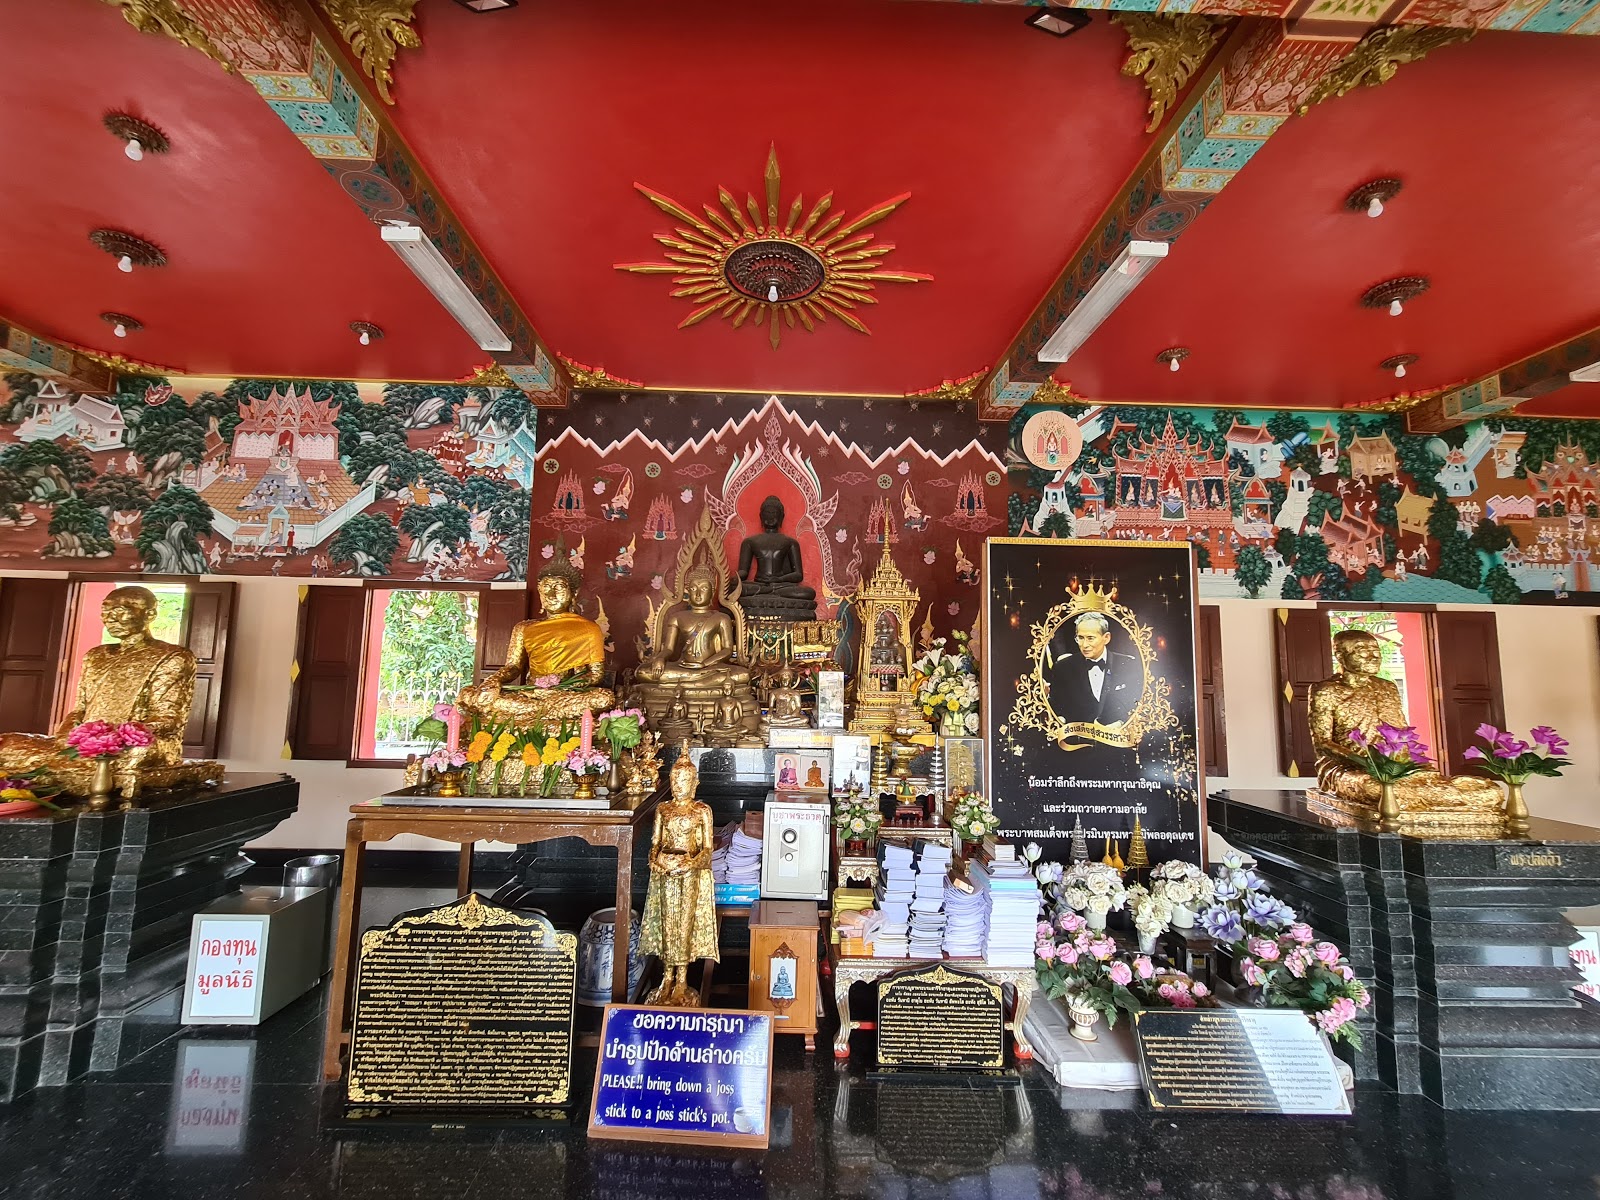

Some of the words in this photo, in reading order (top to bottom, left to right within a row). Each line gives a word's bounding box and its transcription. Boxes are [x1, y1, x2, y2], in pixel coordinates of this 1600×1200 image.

[1028, 775, 1161, 793] น้อมรำลึกถึงพระมหากรุณาธิคุณ
[1043, 802, 1148, 815] และร่วมถวายความอาลัย
[201, 938, 257, 965] กองทุน
[198, 970, 254, 995] มูลนิธิ
[632, 1013, 744, 1037] ขอความกรุณา
[605, 1038, 767, 1065] นำธูปปักด้านล่างครับ
[602, 1073, 643, 1090] PLEASE!!
[647, 1076, 671, 1095] bring
[675, 1077, 702, 1093] down
[706, 1083, 712, 1093] a
[716, 1080, 735, 1096] joss
[605, 1103, 627, 1118] stick
[631, 1105, 642, 1119] to
[645, 1109, 652, 1120] a
[655, 1106, 674, 1123] joss
[678, 1106, 707, 1123] stick's
[711, 1110, 730, 1127] pot.
